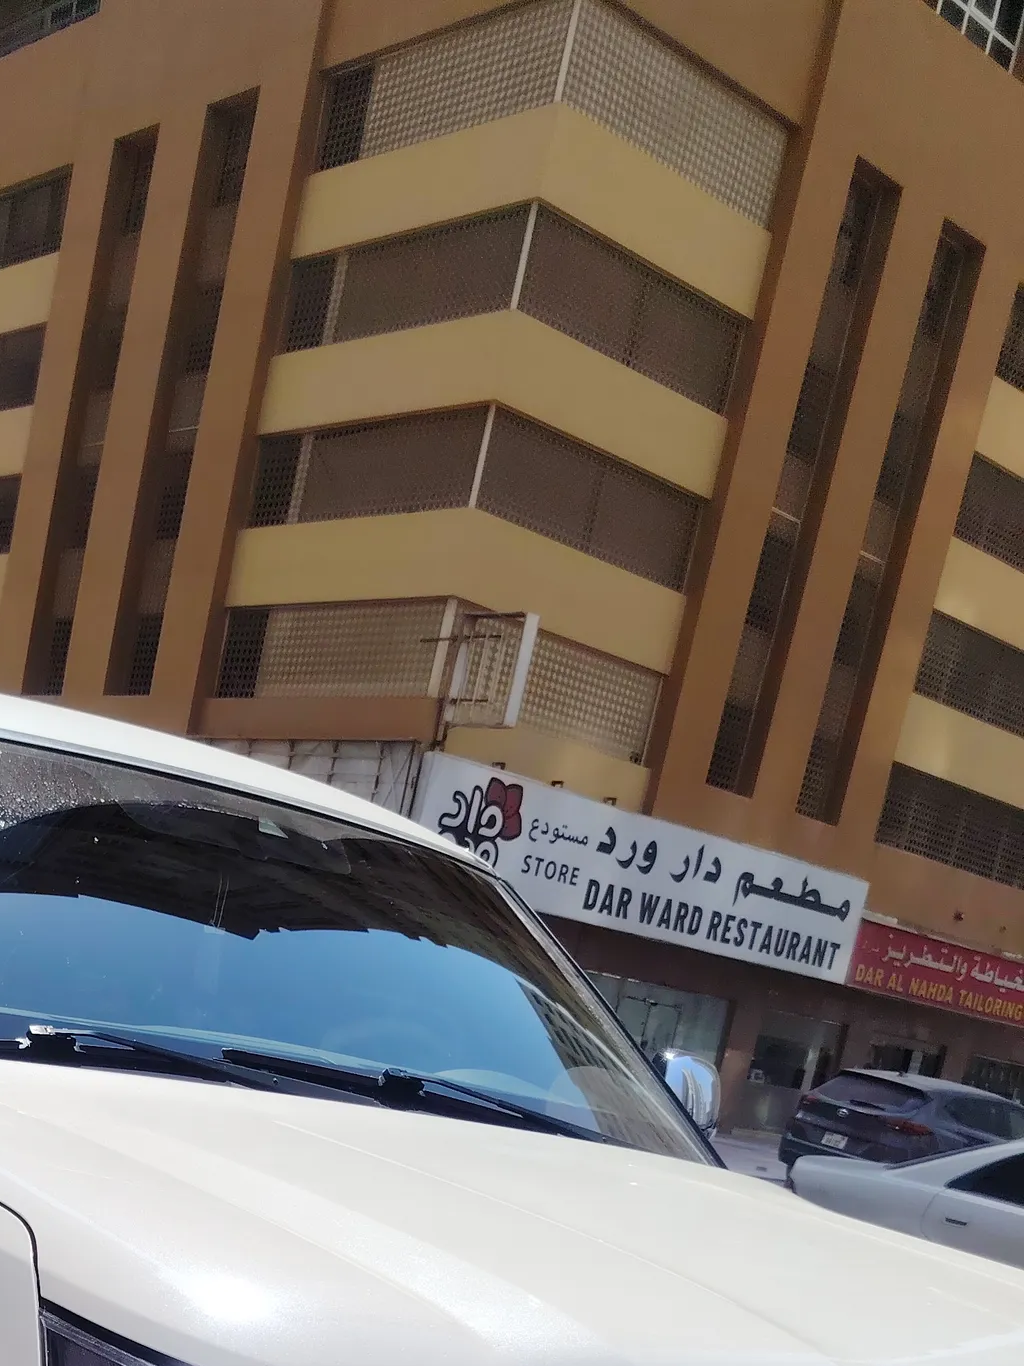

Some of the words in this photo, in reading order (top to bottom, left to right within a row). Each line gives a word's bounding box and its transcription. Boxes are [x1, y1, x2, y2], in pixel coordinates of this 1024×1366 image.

[528, 818, 589, 847] مستودع
[595, 826, 658, 875] ورد
[521, 855, 580, 886] STORE
[669, 844, 722, 883] دار
[732, 871, 851, 922] مطعم
[582, 879, 633, 920] DAR
[638, 892, 703, 936] WARD
[705, 911, 842, 970] RESTAURANT
[881, 933, 968, 981] والتطريز
[970, 956, 1024, 992] خياطة
[855, 964, 885, 987] DAR
[887, 972, 904, 993] AL
[908, 977, 954, 1004] NAHDA
[958, 989, 1024, 1021] TAILORING
